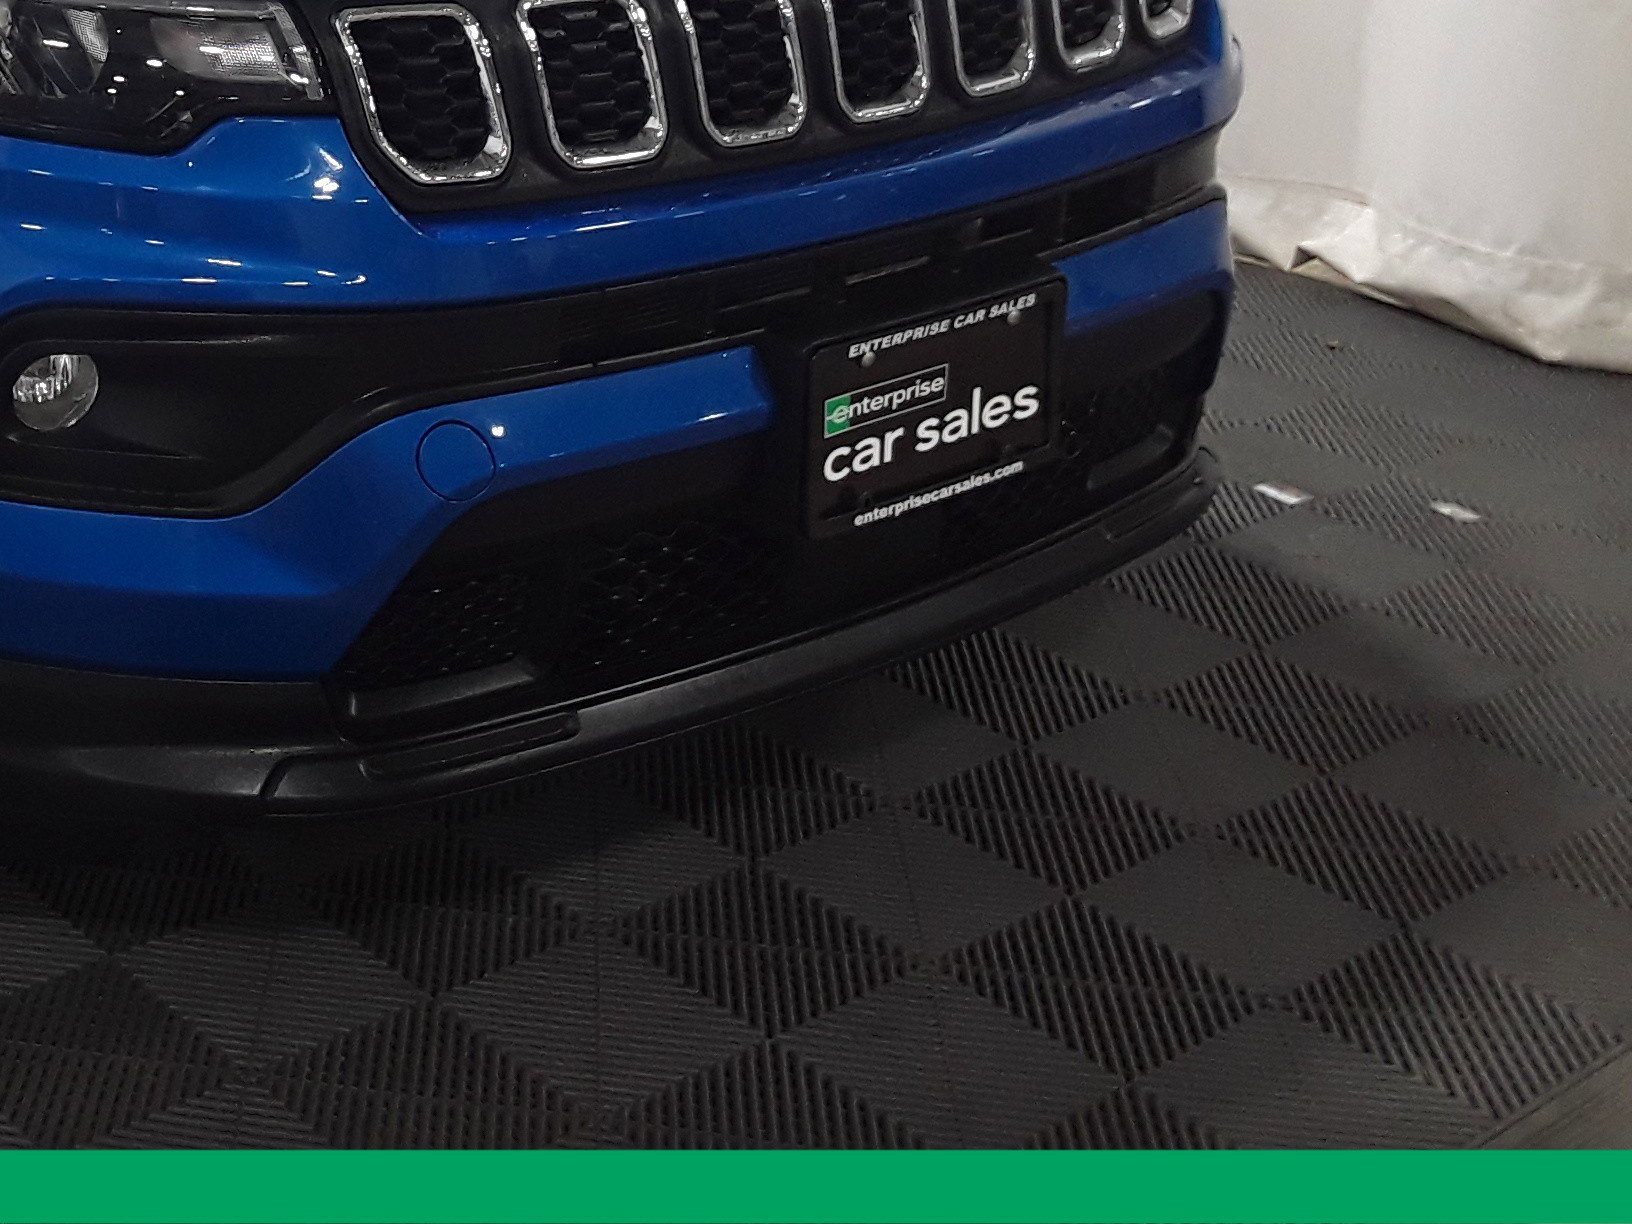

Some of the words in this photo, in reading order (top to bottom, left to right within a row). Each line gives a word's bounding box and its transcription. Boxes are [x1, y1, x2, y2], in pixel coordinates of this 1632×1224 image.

[848, 318, 950, 359] ENTERPRISE
[953, 305, 987, 330] CAR
[989, 292, 1036, 319] SALES
[823, 426, 905, 482] car
[915, 384, 1040, 453] sales
[831, 376, 945, 424] enterprise
[853, 460, 1025, 527] enterprisecarsales.com
